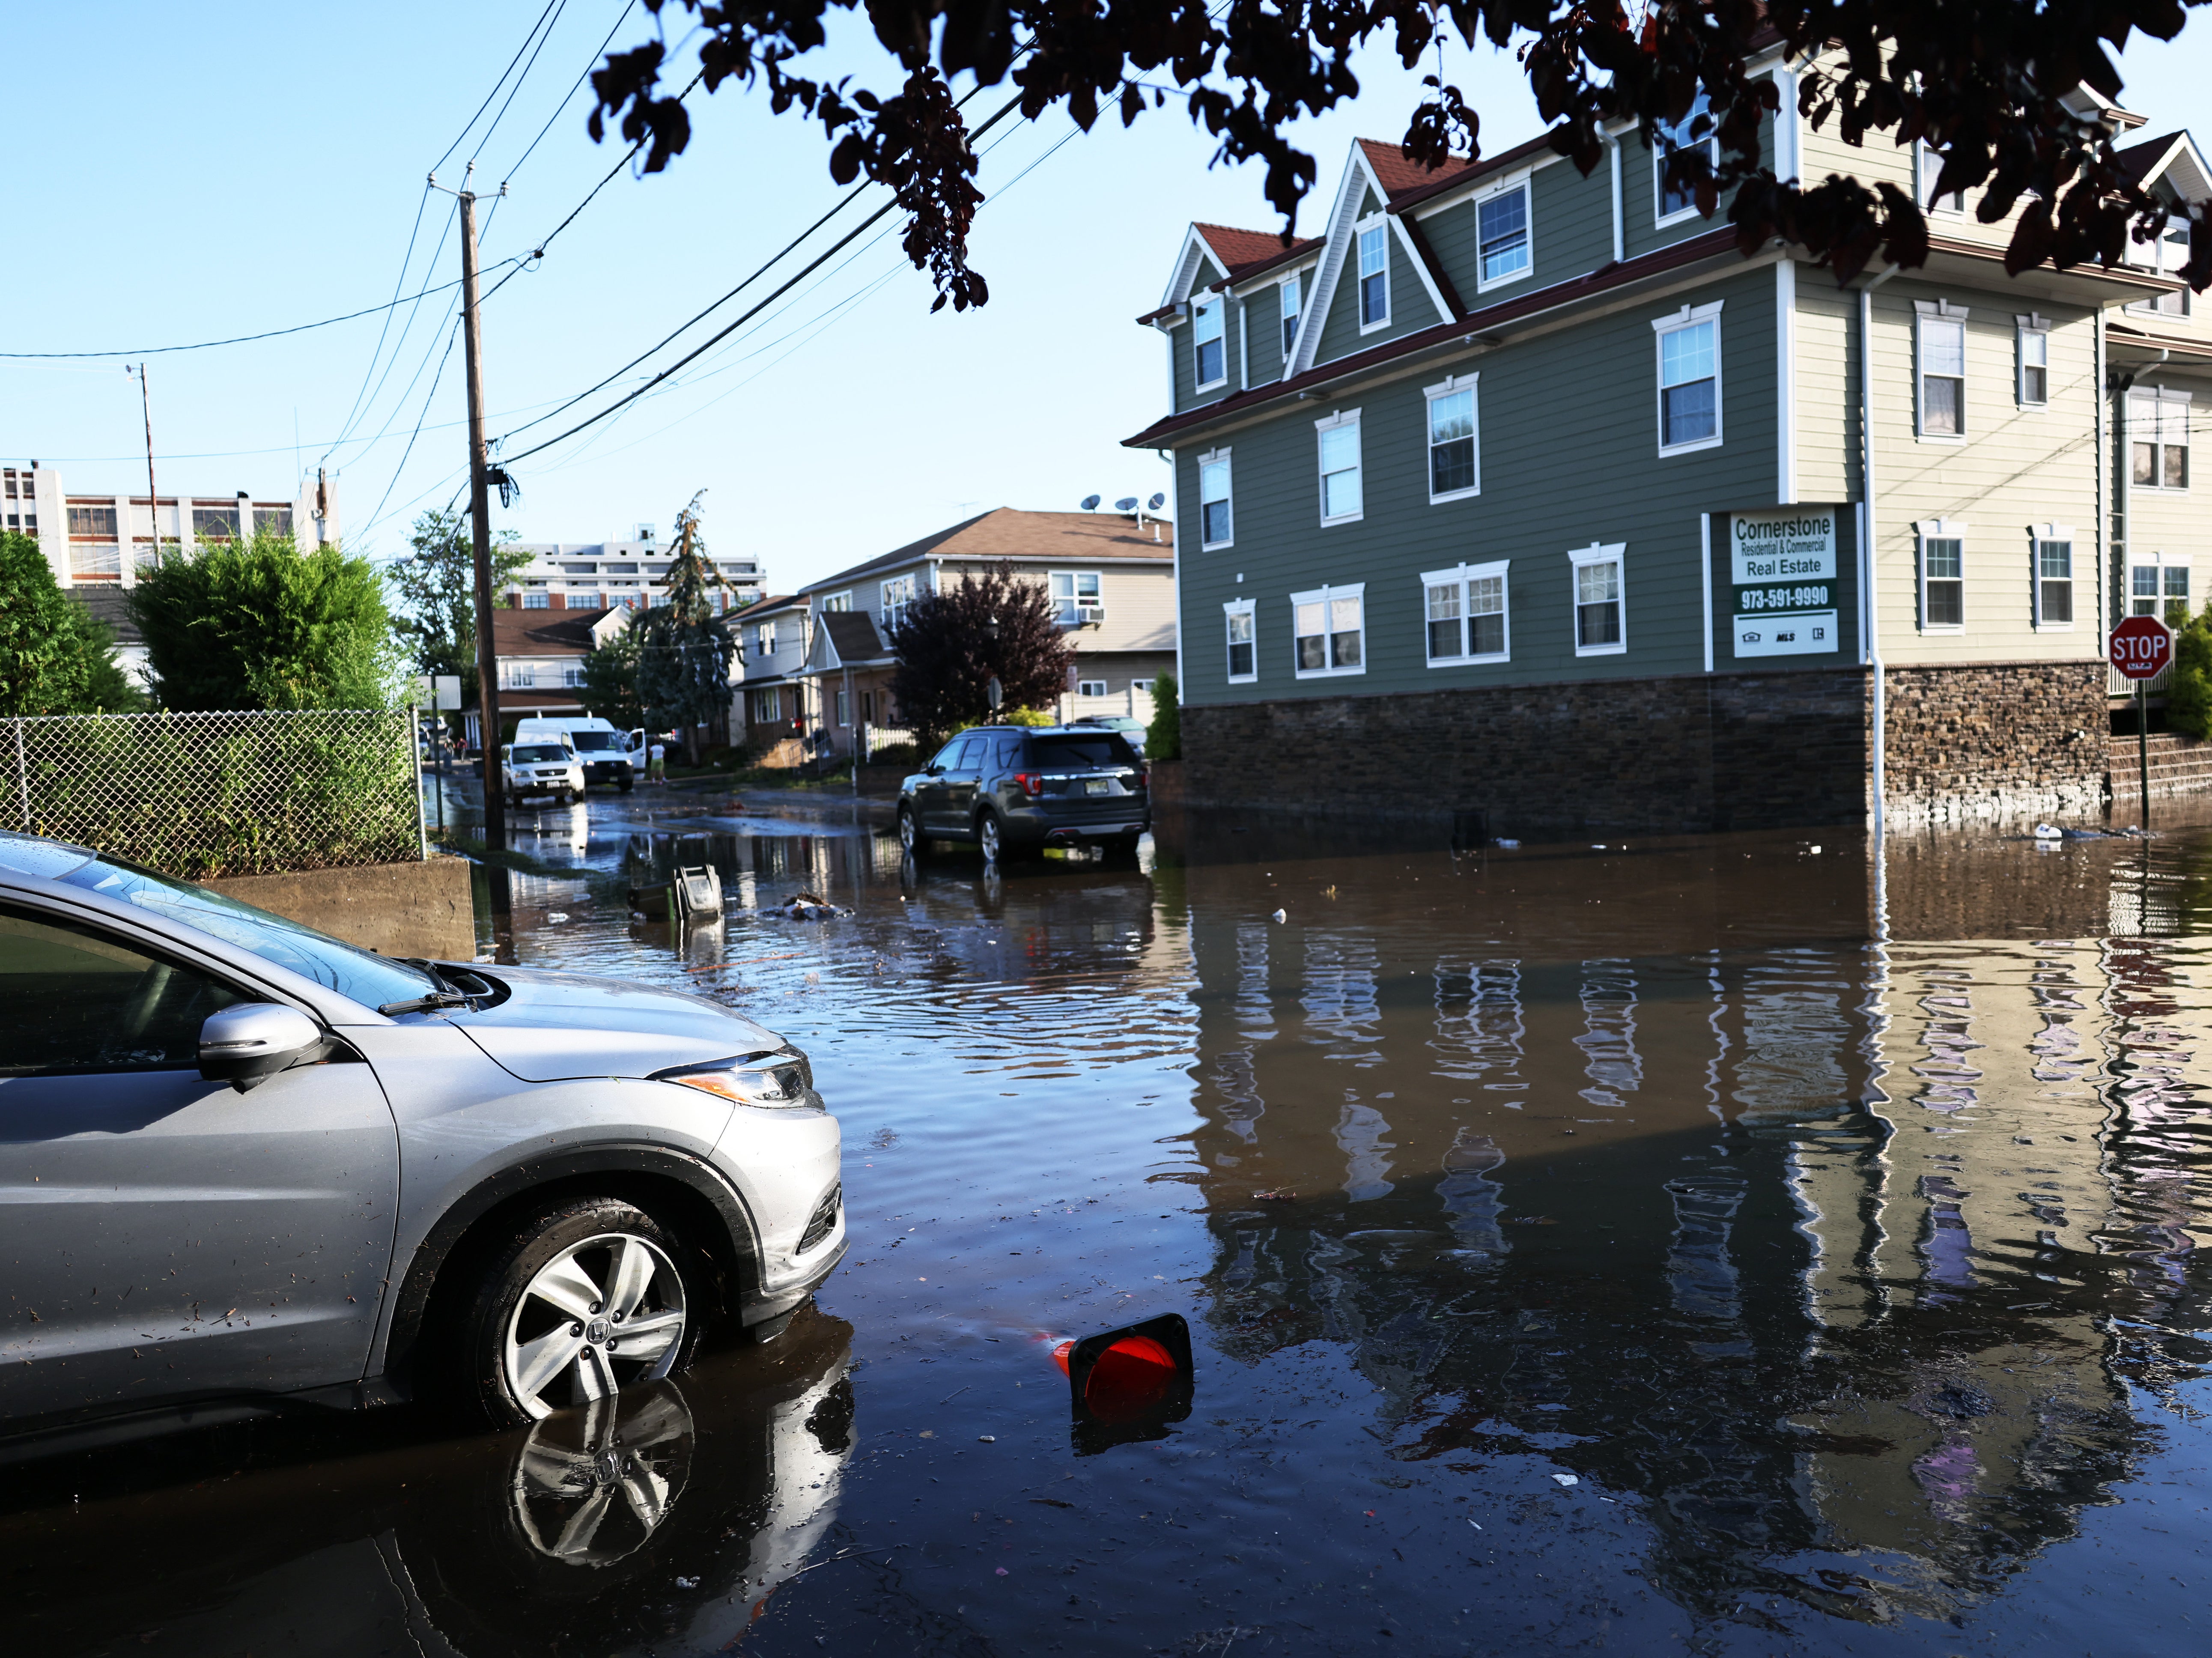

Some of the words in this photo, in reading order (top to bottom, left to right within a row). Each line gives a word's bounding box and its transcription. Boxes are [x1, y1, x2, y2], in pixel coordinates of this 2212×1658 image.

[1737, 516, 1830, 540] Cornerstone
[1741, 540, 1778, 557] Residential
[1780, 539, 1785, 553] &
[1786, 536, 1826, 554] Commercial
[1747, 560, 1776, 576] Real
[1780, 558, 1821, 574] Estate
[1742, 585, 1827, 609] 973-591-9990
[1777, 633, 1795, 642] MLS
[2114, 635, 2167, 660] STOP
